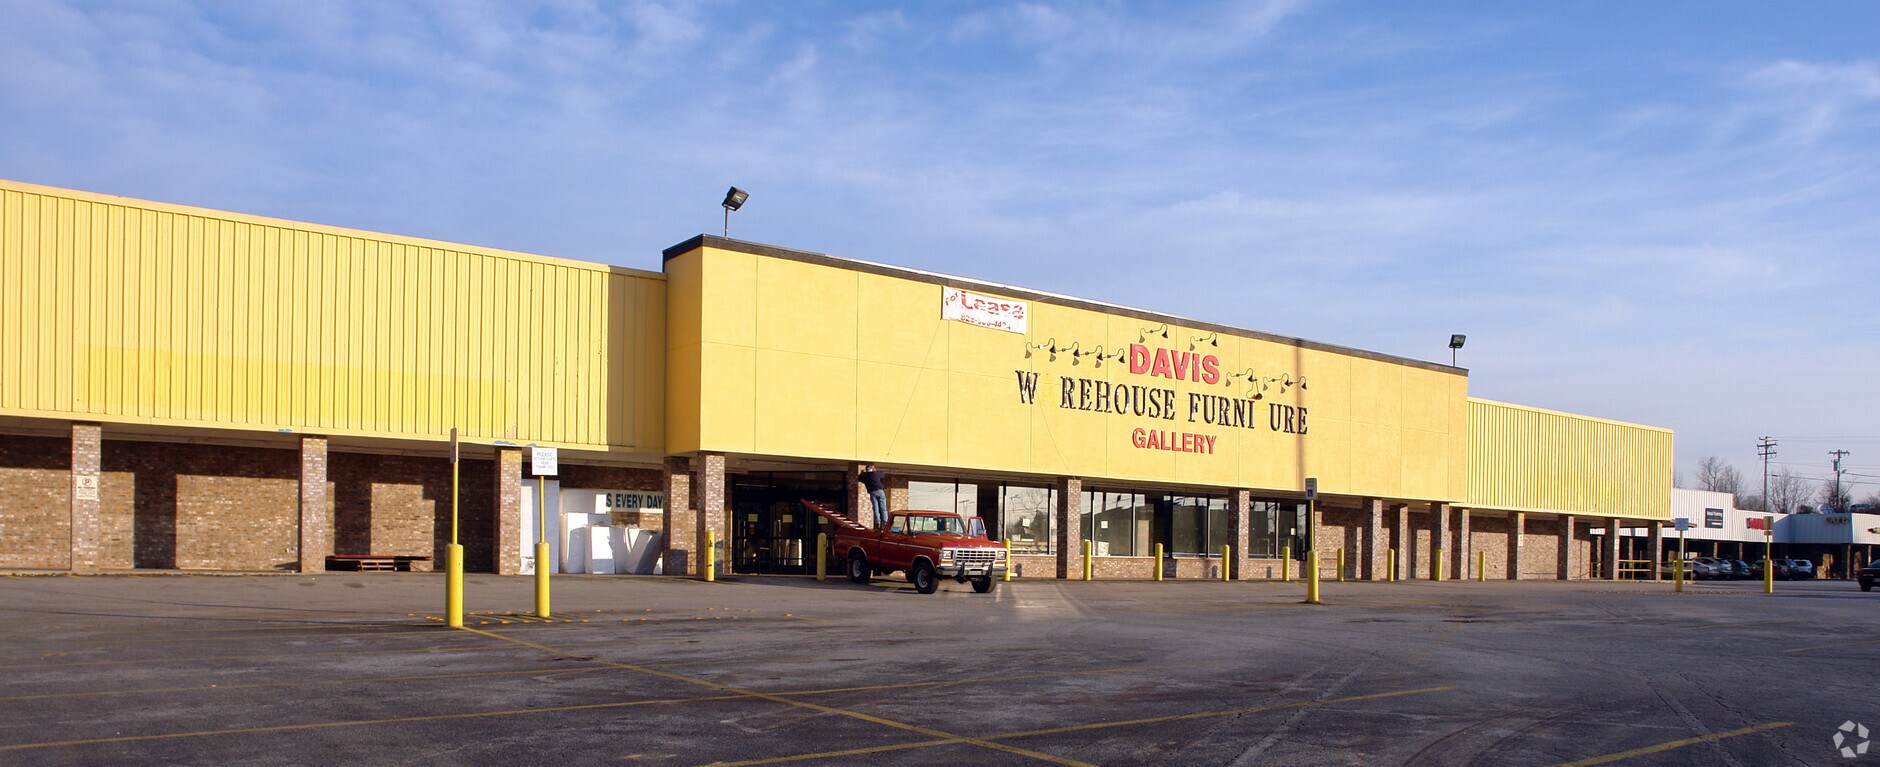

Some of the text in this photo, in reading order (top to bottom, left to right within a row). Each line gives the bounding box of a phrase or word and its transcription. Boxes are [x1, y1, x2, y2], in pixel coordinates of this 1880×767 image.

[1129, 343, 1220, 385] DAVIS
[1132, 427, 1217, 454] GALLERY
[615, 493, 643, 508] EVERY
[646, 495, 663, 509] DAY
